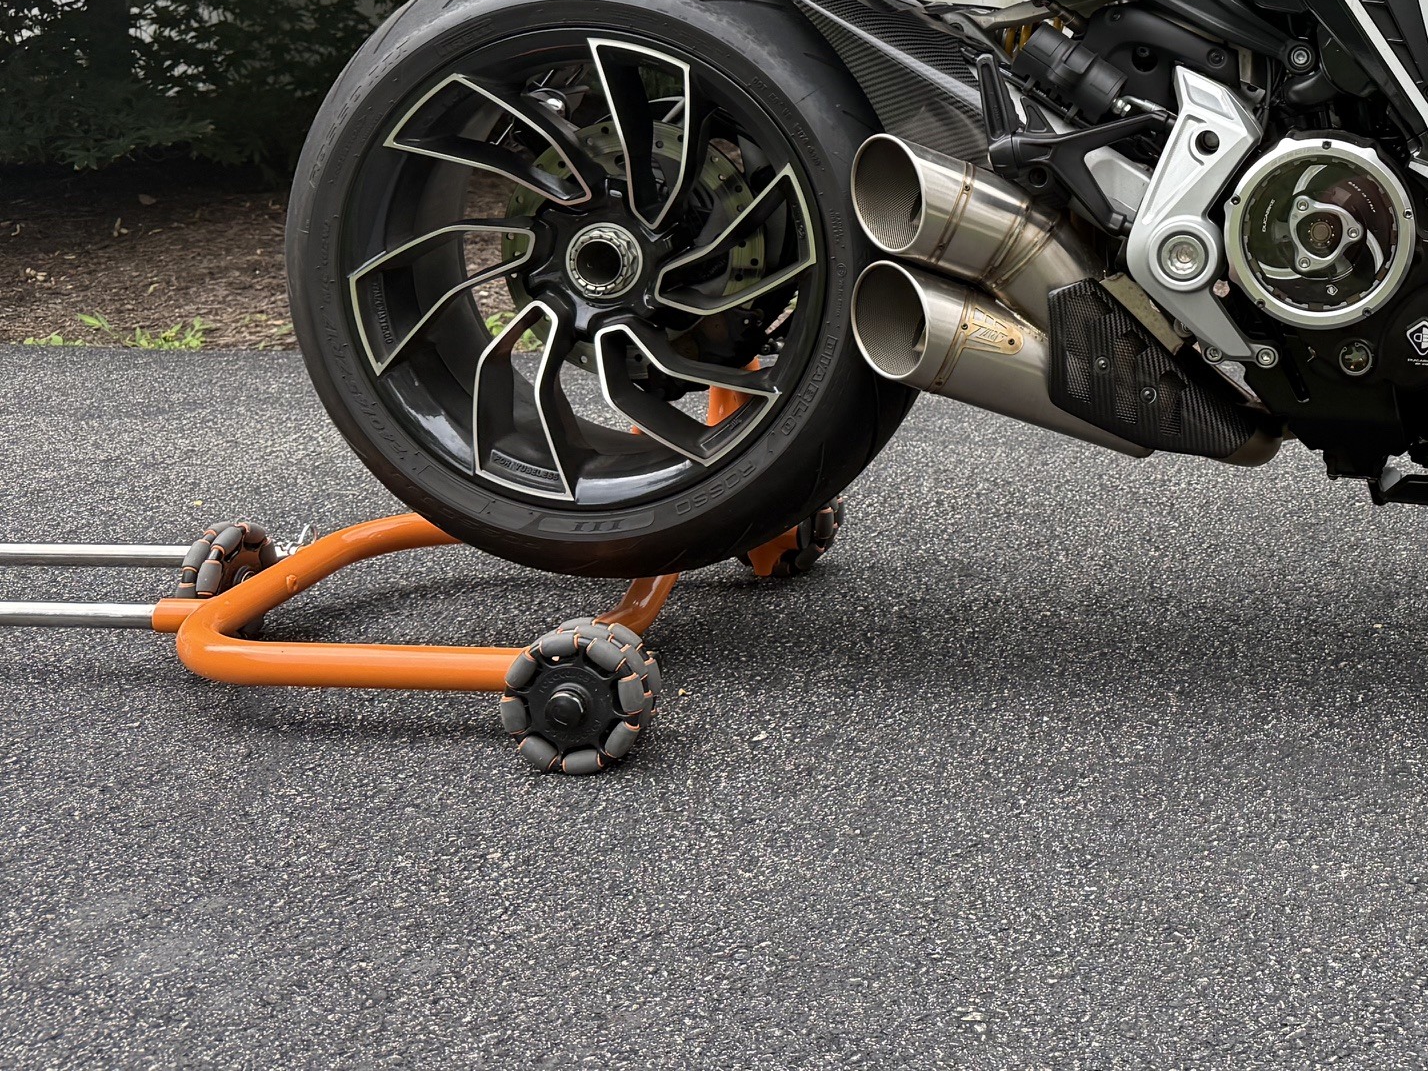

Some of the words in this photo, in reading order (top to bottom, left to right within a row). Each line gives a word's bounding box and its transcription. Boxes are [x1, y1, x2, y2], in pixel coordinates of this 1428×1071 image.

[777, 332, 840, 438] DIABLO
[493, 455, 512, 469] FOR
[674, 457, 761, 516] ROSSO
[570, 517, 629, 532] III
